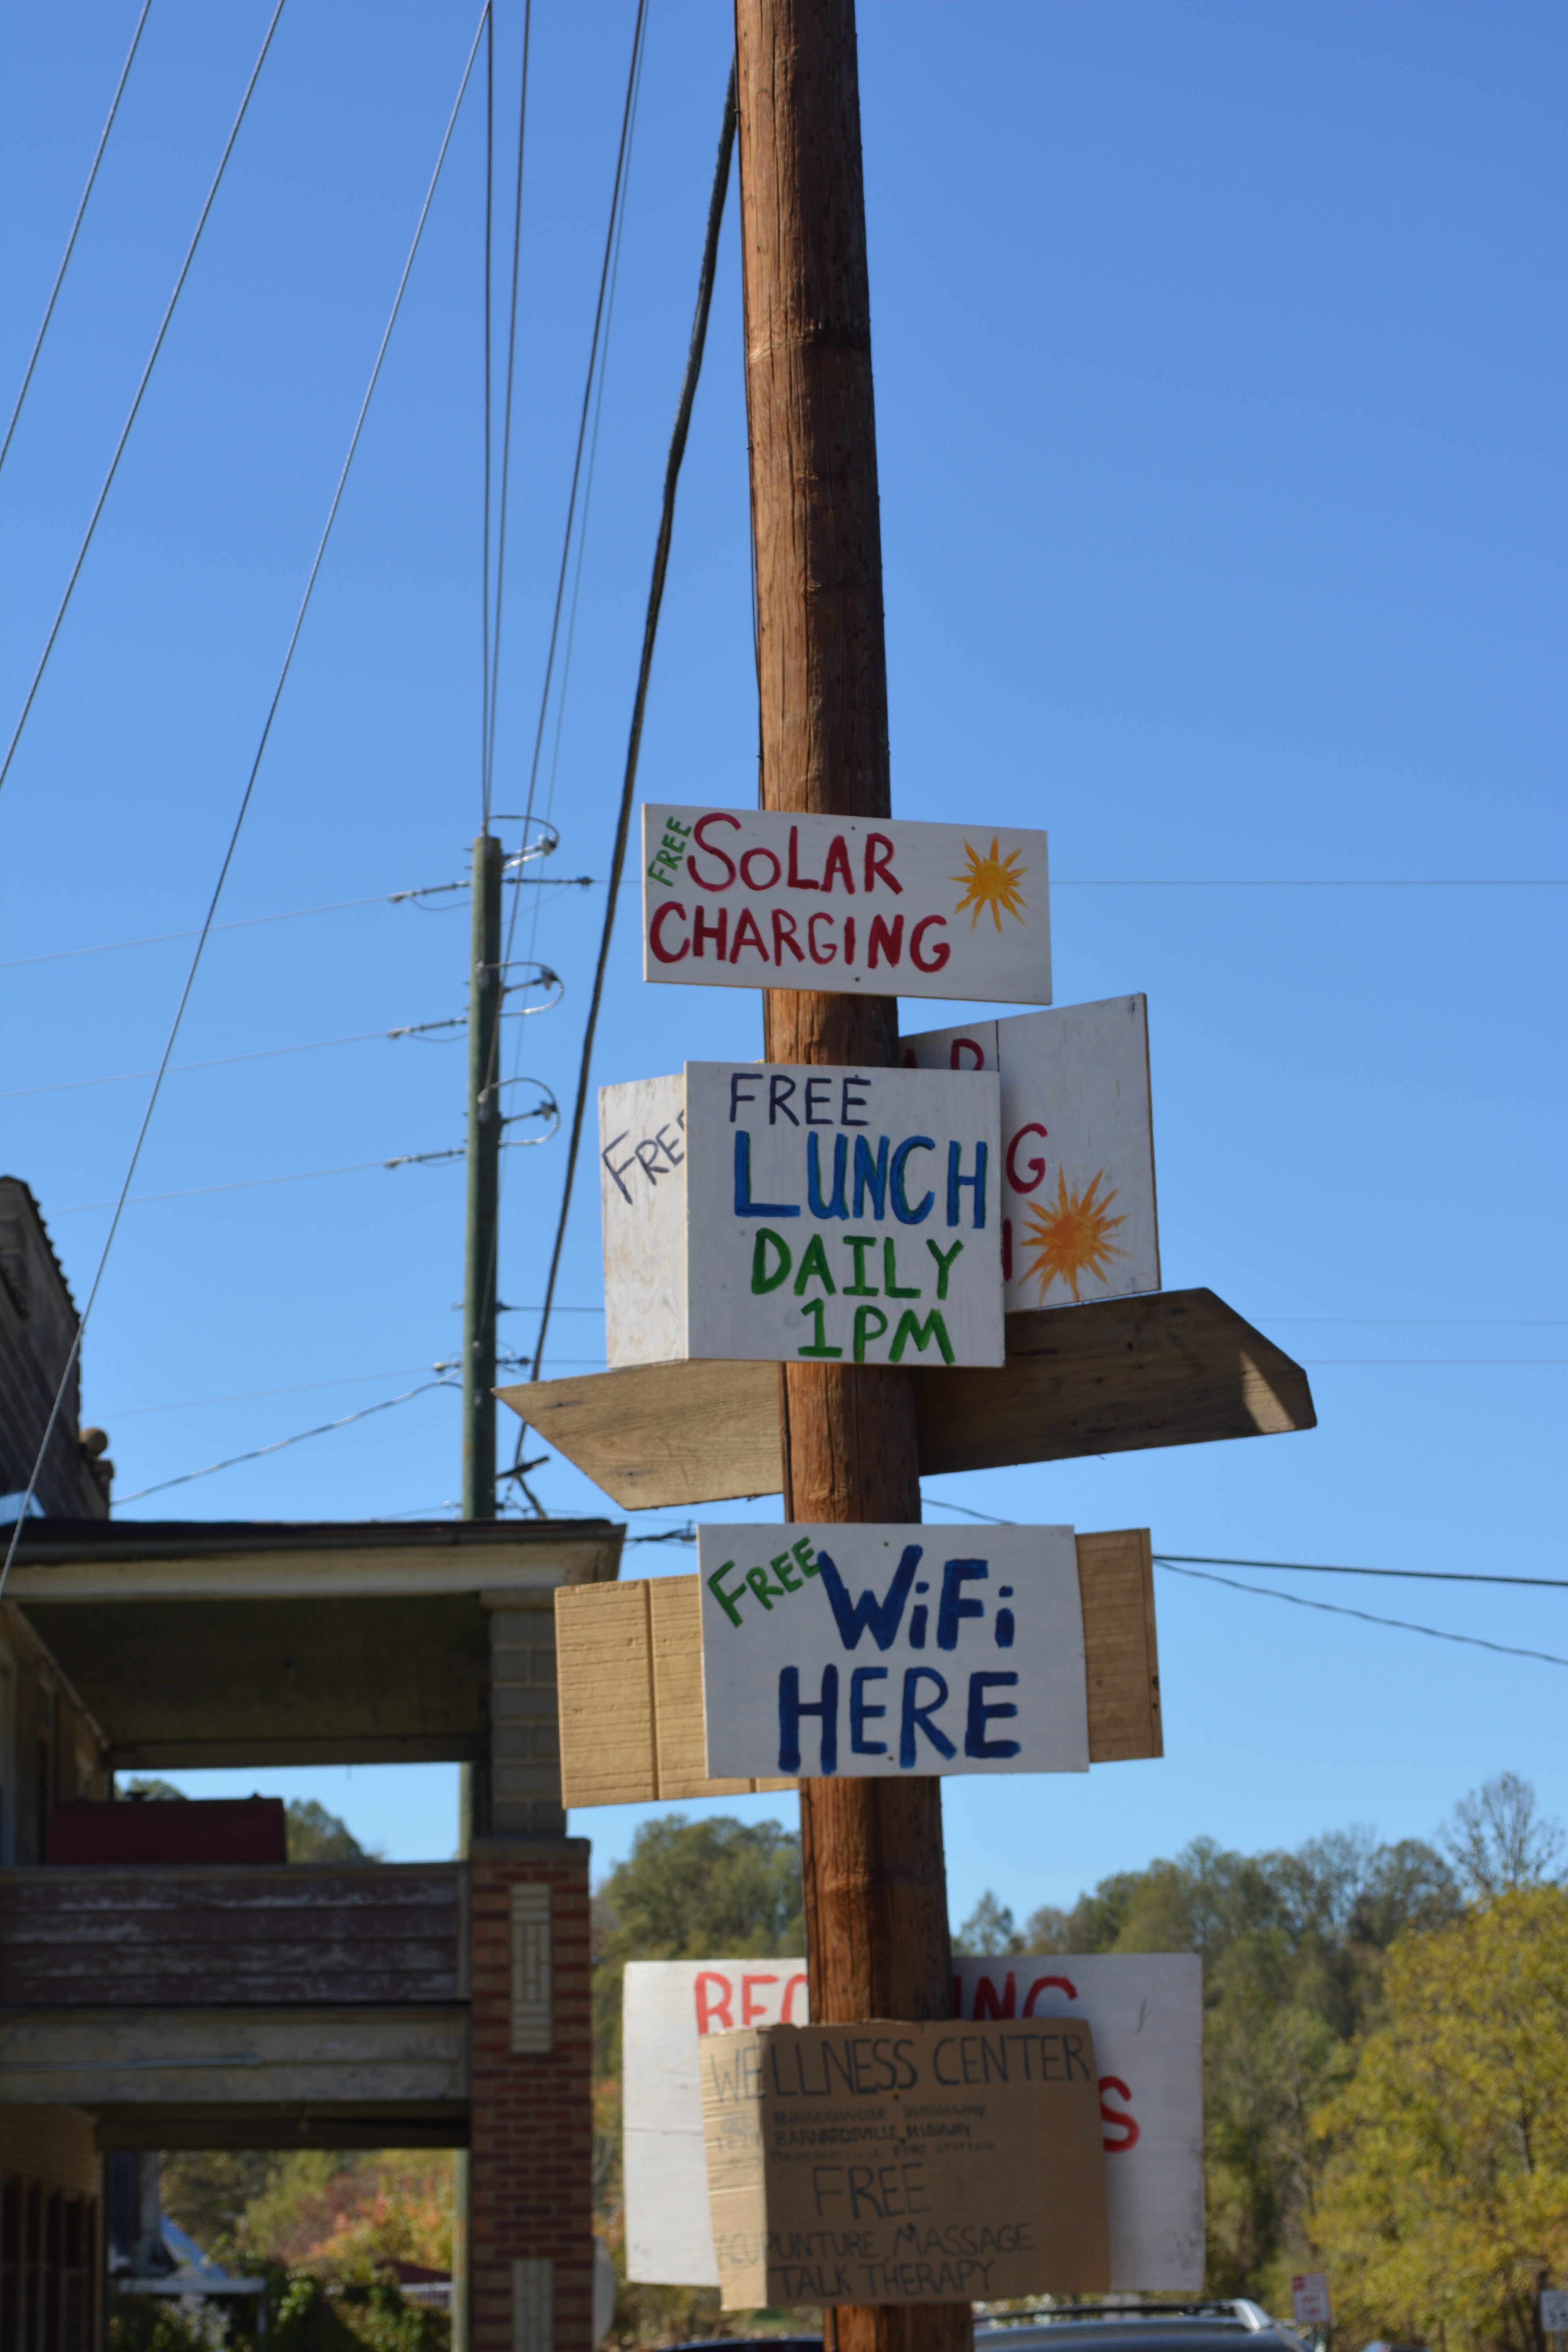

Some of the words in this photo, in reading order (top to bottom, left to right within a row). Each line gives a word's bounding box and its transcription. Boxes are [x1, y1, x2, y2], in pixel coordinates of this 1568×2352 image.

[648, 815, 692, 887] FREE
[687, 813, 903, 895] SOLAR
[649, 901, 951, 973] CHARGING
[729, 1073, 871, 1127] FREE
[734, 1130, 987, 1229] LUNCH
[751, 1228, 964, 1301] DAILY
[798, 1298, 955, 1365] 1PM
[706, 1536, 821, 1628] FREE
[778, 1664, 1021, 1775] HERE
[710, 2038, 918, 2103] WELLNESS
[934, 2034, 1090, 2086] CENTER
[813, 2163, 932, 2220] FREE
[892, 2222, 1036, 2259] MASSAGE
[769, 2265, 853, 2299] TALK
[859, 2259, 995, 2297] THERAPY
